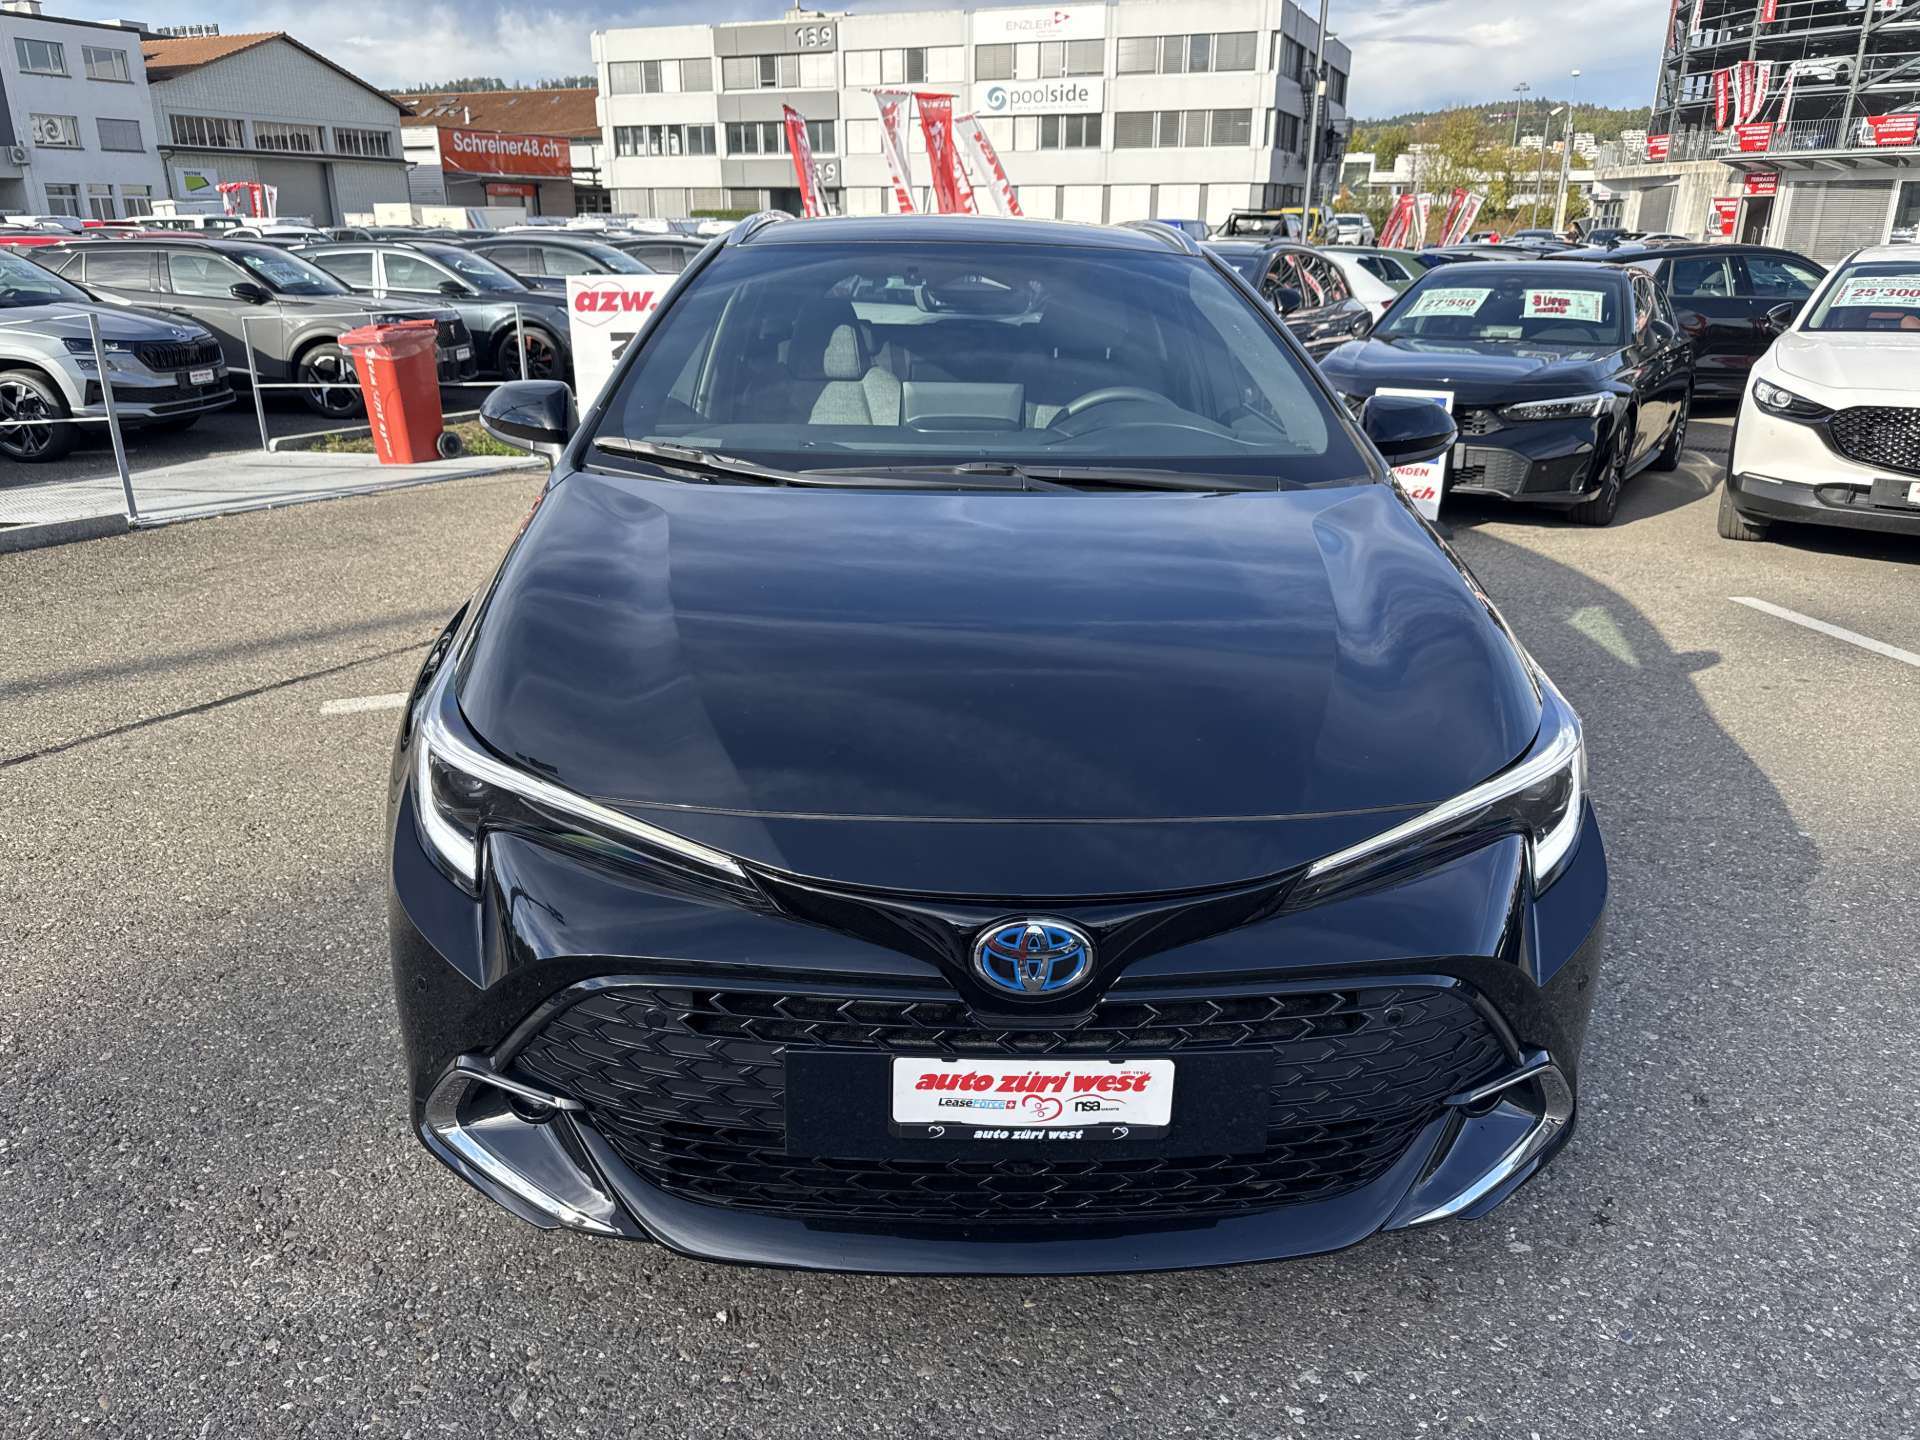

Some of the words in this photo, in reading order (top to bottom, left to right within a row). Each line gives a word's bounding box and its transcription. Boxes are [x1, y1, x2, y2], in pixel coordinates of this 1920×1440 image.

[1005, 18, 1053, 31] ENZLER
[794, 26, 832, 47] 139
[1010, 83, 1089, 111] poolside
[452, 131, 560, 158] Schreiner48.ch
[914, 1071, 995, 1092] auto
[994, 1071, 1071, 1093] züri
[1073, 1072, 1152, 1092] west
[938, 1097, 1005, 1110] LeaseForce
[1074, 1101, 1101, 1112] nsa
[973, 1129, 1009, 1140] auto
[1011, 1129, 1045, 1140] züri
[1048, 1129, 1084, 1140] west
